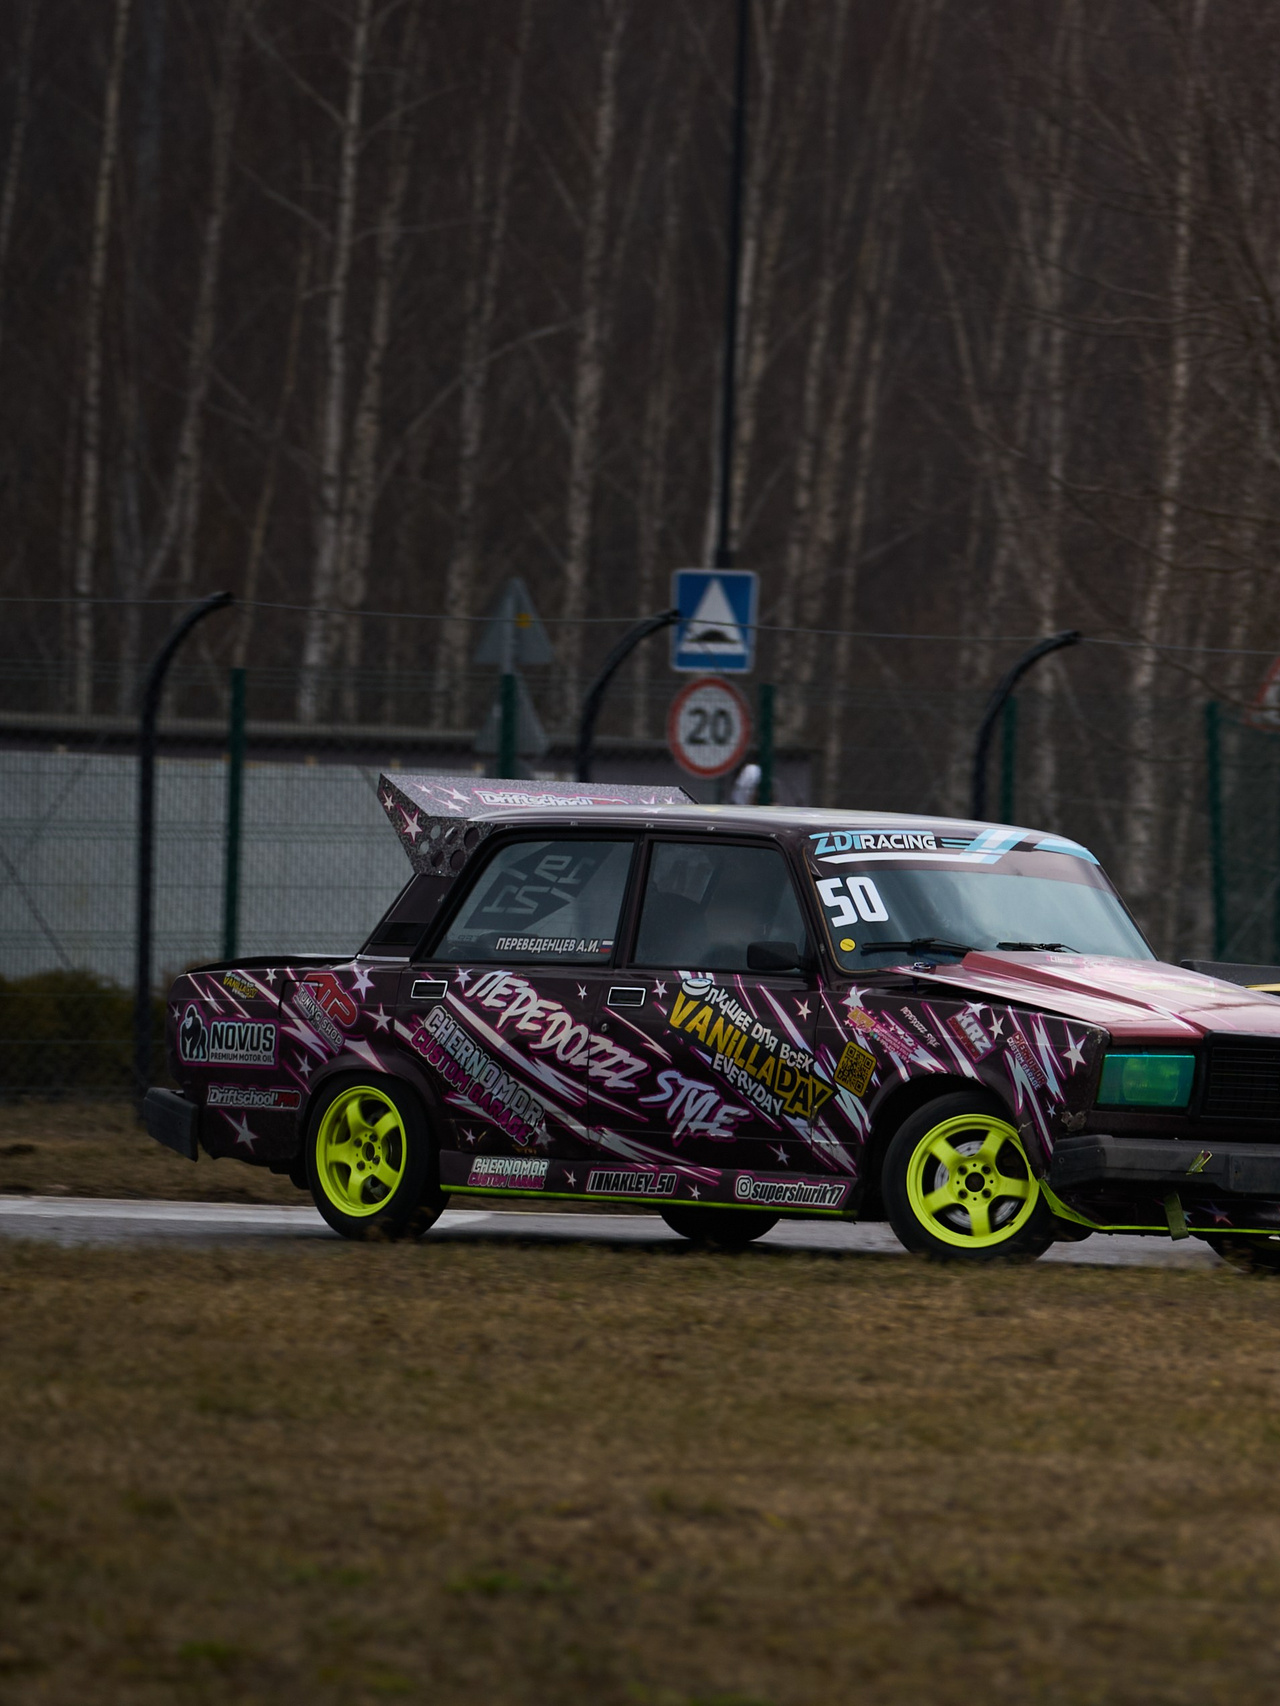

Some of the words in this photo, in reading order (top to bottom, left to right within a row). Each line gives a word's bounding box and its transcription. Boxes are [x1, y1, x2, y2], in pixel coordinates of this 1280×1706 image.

[687, 707, 734, 745] 20
[816, 876, 889, 928] 50
[496, 938, 575, 954] ПЕРЕВЕДЕНЦЕВ
[576, 940, 600, 953] А.И.
[211, 1023, 274, 1051] NOVUS
[299, 987, 322, 1020] TUNING
[321, 1019, 344, 1047] SHOP
[954, 1012, 992, 1055] KRZ
[210, 1052, 238, 1061] PREMIUM
[239, 1053, 261, 1062] MOTOR
[262, 1054, 273, 1063] OIL
[424, 1006, 544, 1125] CHERNOMOR
[780, 1043, 815, 1073] ВСЕХ
[1006, 1036, 1025, 1064] CUSTOM
[1021, 1062, 1041, 1091] GARAGE
[411, 1028, 468, 1091] CUSTOM
[469, 1083, 534, 1142] GARAGE
[712, 1053, 784, 1116] EVERYDAY
[639, 1070, 751, 1141] STYLE
[467, 1172, 507, 1186] CUSTOM
[471, 1157, 549, 1177] CHERNOMOR
[751, 1182, 844, 1205] supershurik17
